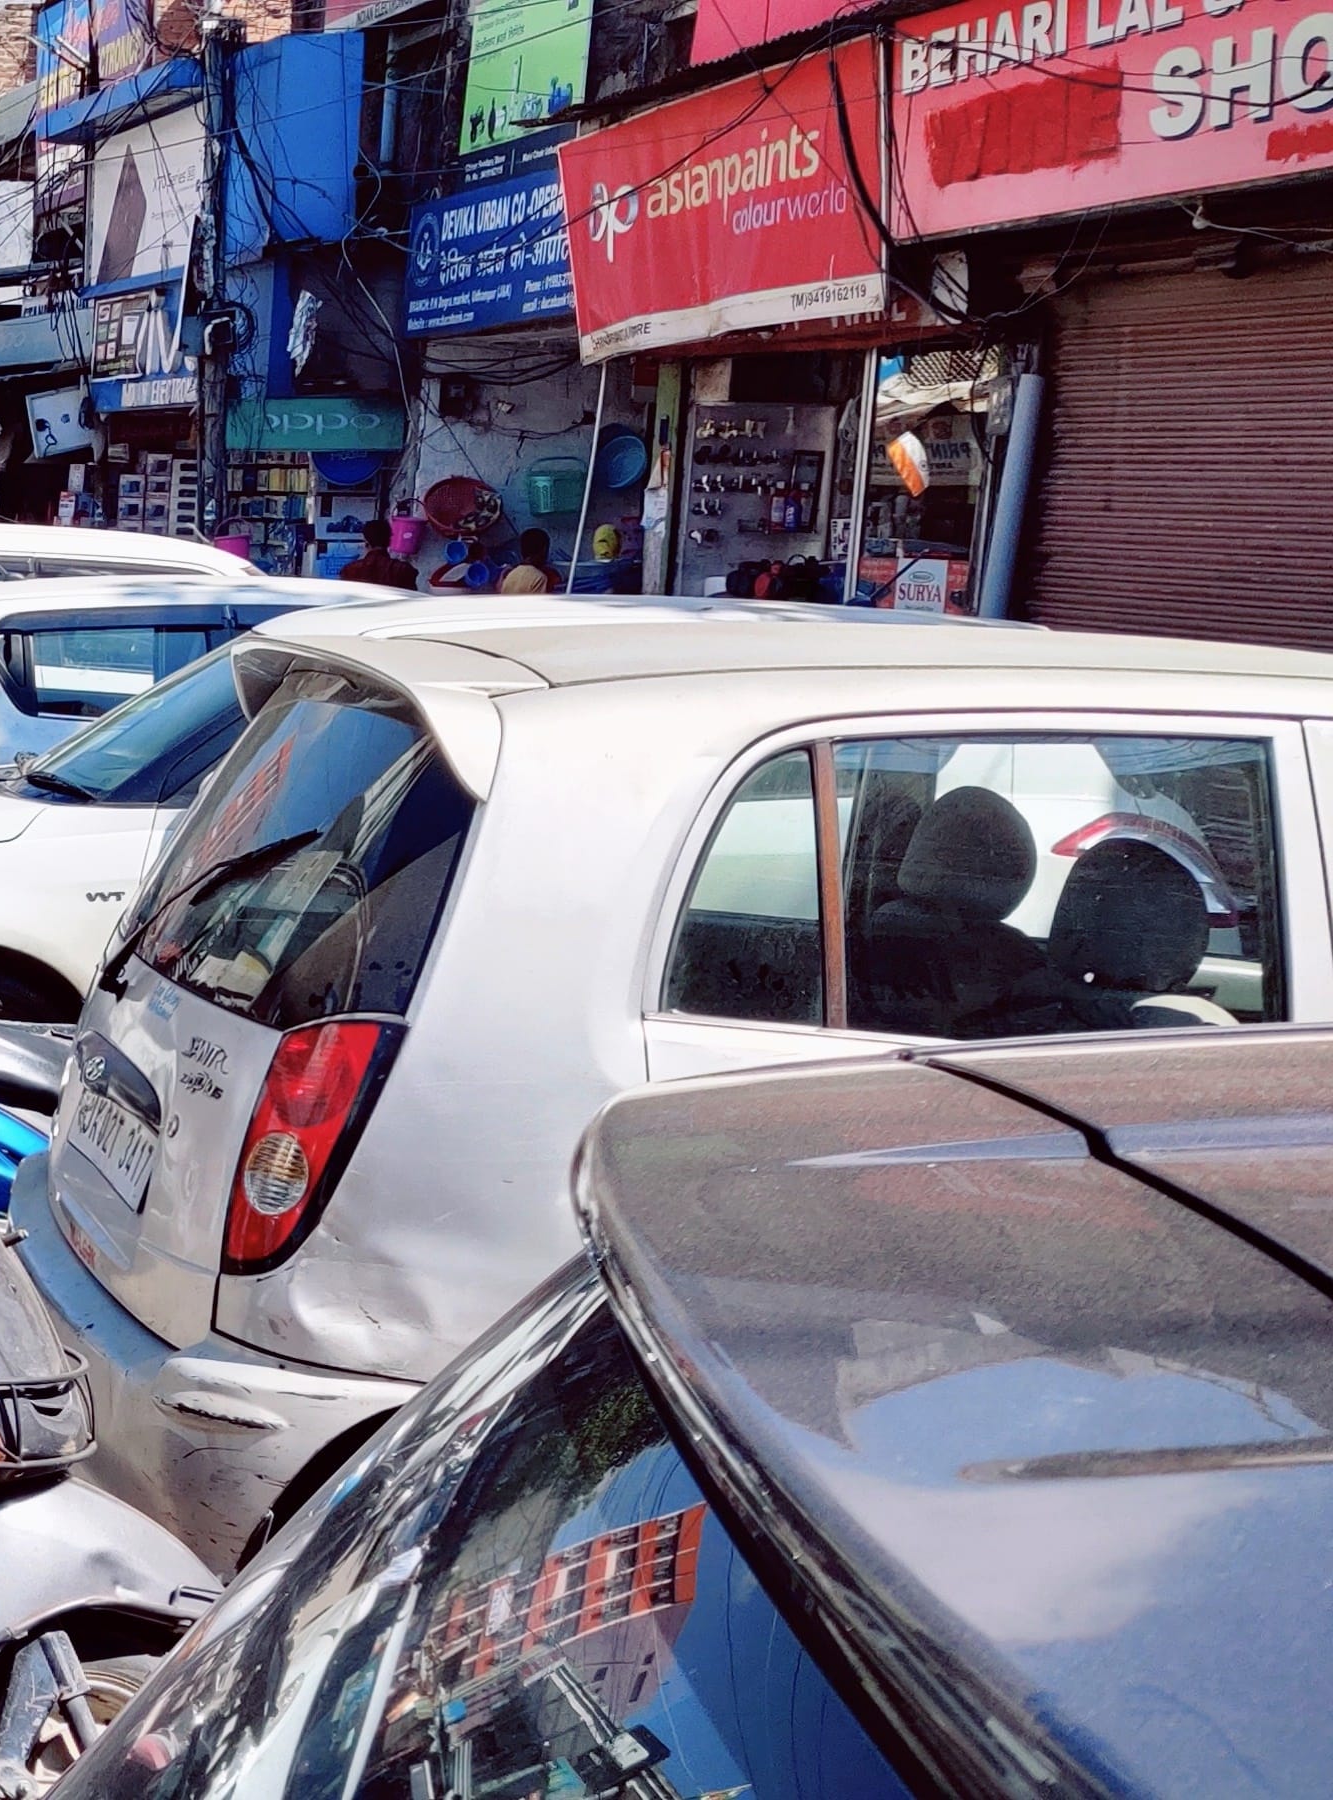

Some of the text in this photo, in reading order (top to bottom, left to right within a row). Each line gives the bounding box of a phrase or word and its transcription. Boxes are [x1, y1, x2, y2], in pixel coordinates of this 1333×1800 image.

[901, 0, 1070, 96] BEHARI
[1148, 12, 1333, 141] SHO
[646, 126, 821, 225] asianpaints
[441, 204, 476, 242] DEVIKA
[477, 195, 511, 234] URBAN
[254, 412, 381, 436] oppo
[897, 583, 942, 603] SURYA
